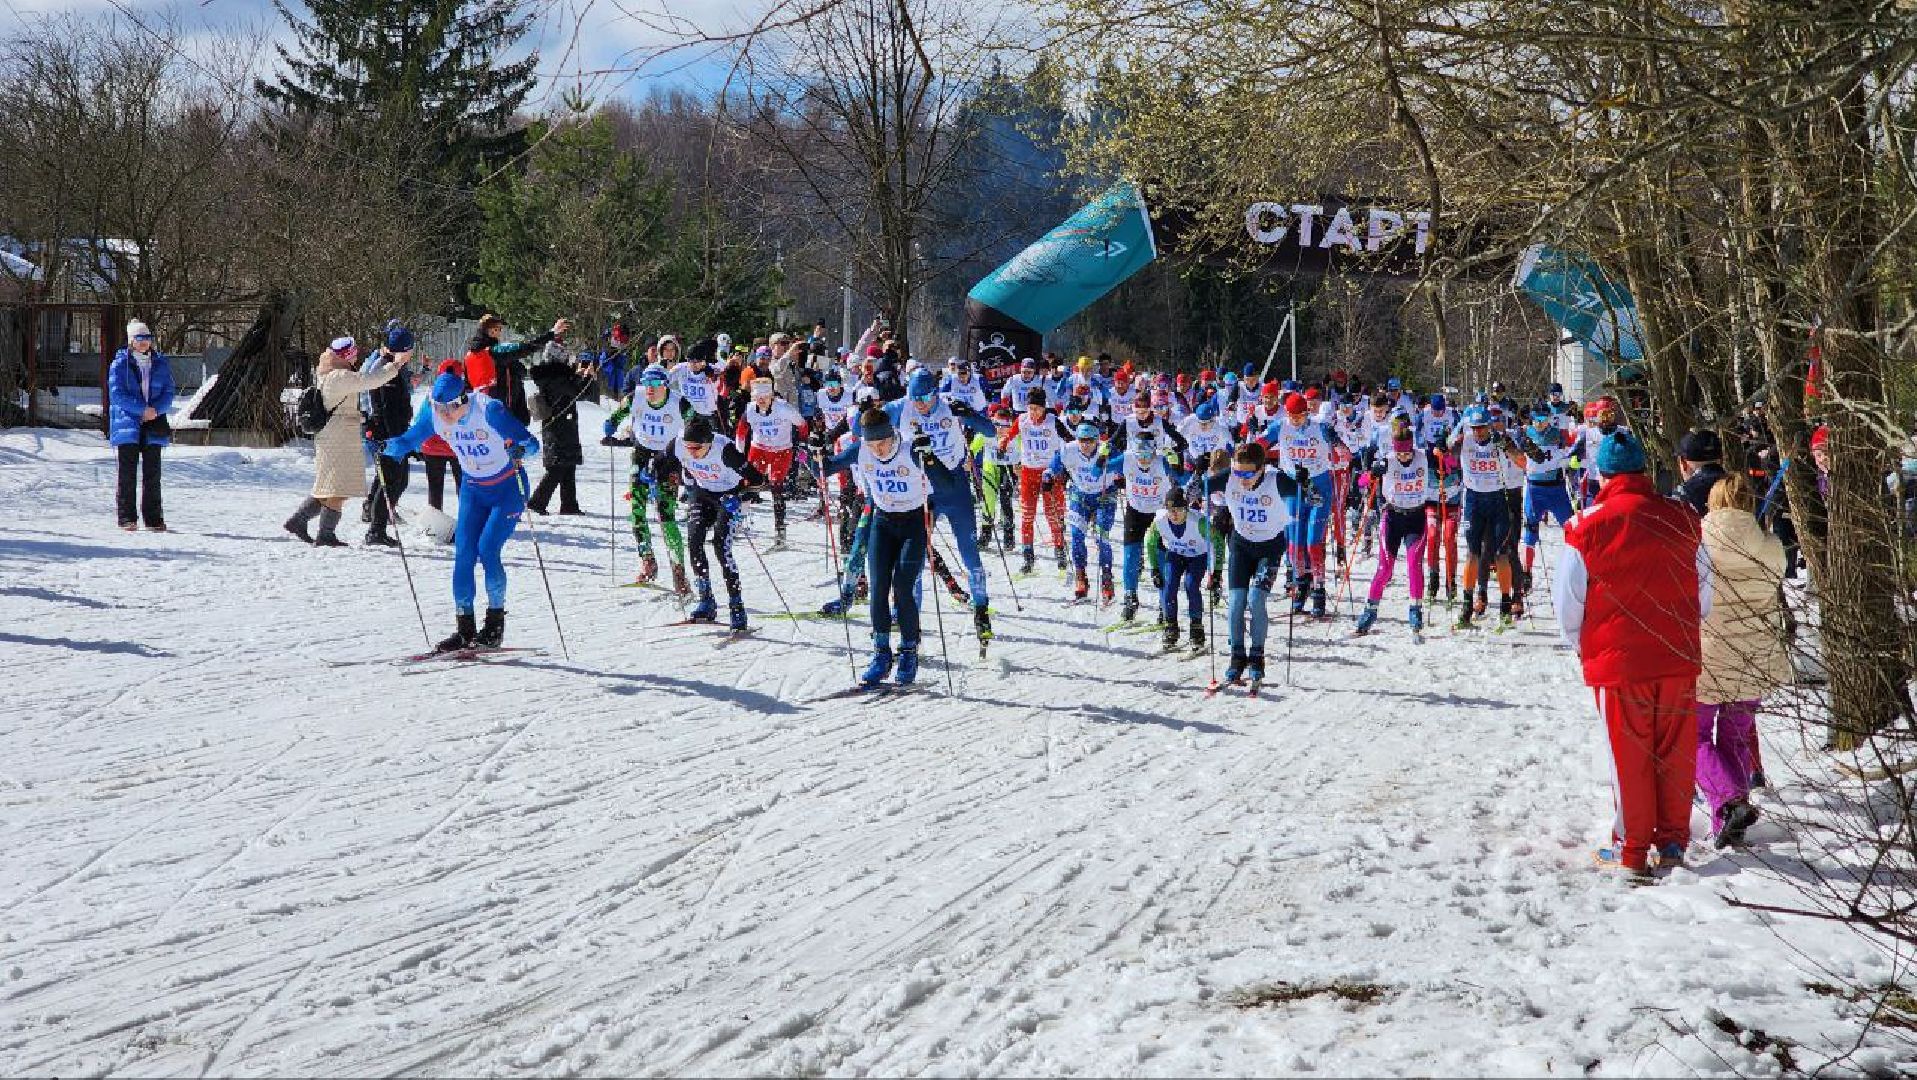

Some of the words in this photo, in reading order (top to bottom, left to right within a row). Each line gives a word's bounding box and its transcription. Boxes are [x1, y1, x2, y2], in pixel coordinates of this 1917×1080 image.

[1245, 202, 1431, 254] СТАРТ
[1287, 446, 1317, 459] 302
[875, 479, 908, 493] 120
[1237, 506, 1268, 523] 125
